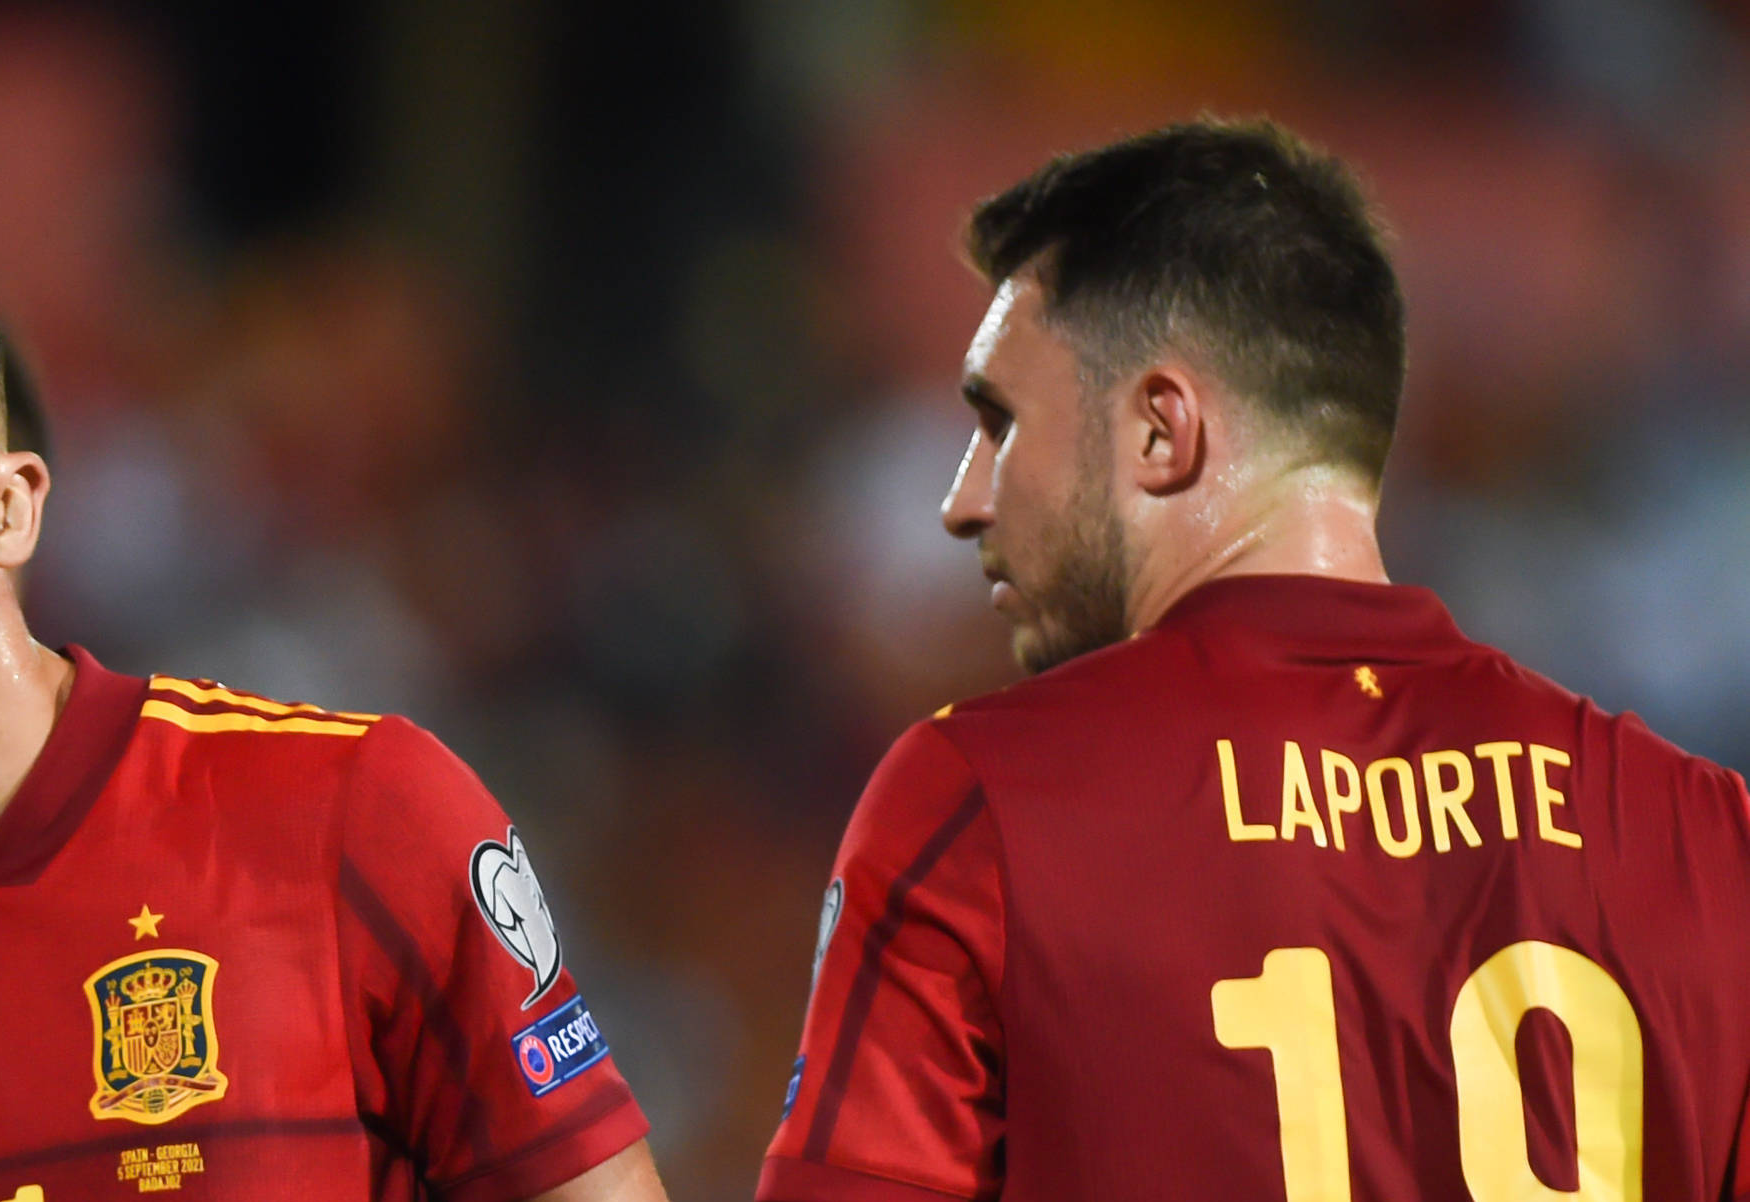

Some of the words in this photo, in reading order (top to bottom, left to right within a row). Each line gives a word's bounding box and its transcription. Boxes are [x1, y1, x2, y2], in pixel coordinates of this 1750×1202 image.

[1216, 738, 1584, 859] LAPORTE
[120, 1148, 149, 1165] SPAIN
[156, 1143, 200, 1160] GEORGIA
[125, 1160, 179, 1180] SEPTEMBER
[181, 1157, 205, 1173] 2021
